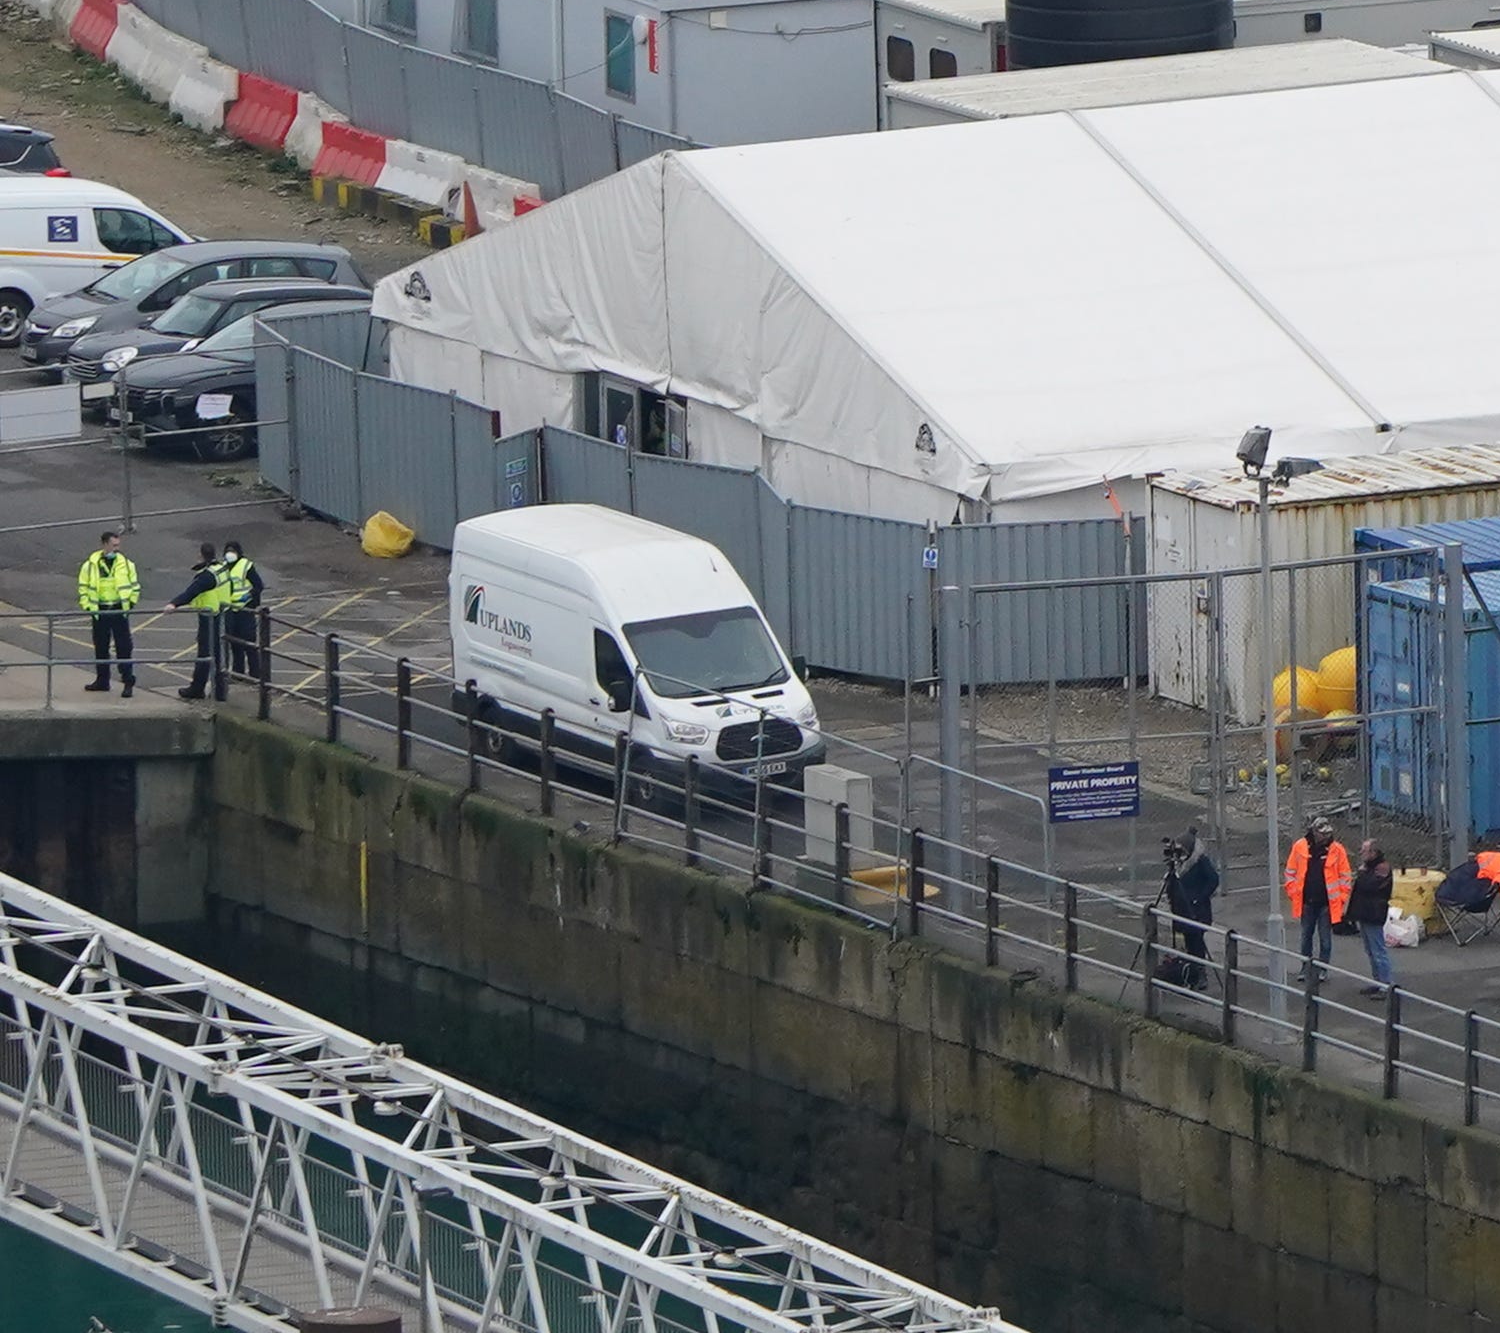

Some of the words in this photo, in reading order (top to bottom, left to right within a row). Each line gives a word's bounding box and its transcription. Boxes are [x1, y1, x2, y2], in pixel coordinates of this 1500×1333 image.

[480, 608, 532, 643] UPLANDS
[1050, 778, 1089, 791] PRIVATE
[1090, 775, 1137, 789] PROPERTY
